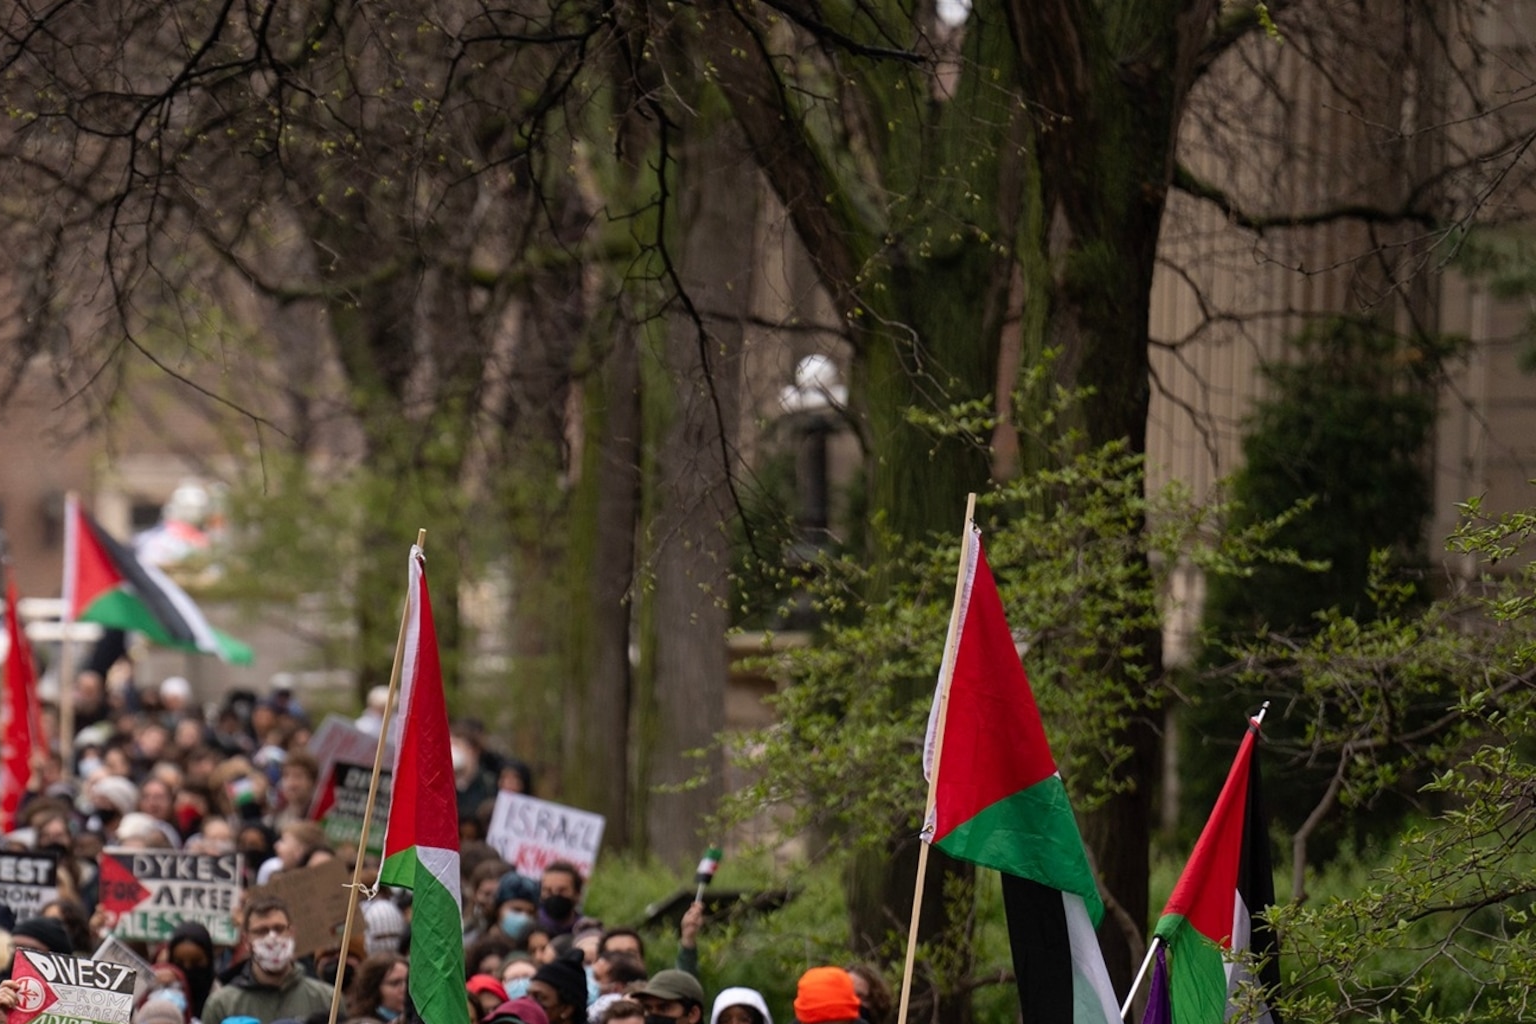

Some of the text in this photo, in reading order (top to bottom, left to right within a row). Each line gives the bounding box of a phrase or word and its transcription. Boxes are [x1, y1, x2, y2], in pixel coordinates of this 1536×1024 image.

[132, 853, 236, 885] DYKES
[155, 884, 177, 907] A
[181, 886, 233, 911] FREE
[24, 951, 136, 991] DIVEST
[53, 985, 132, 1011] FROM
